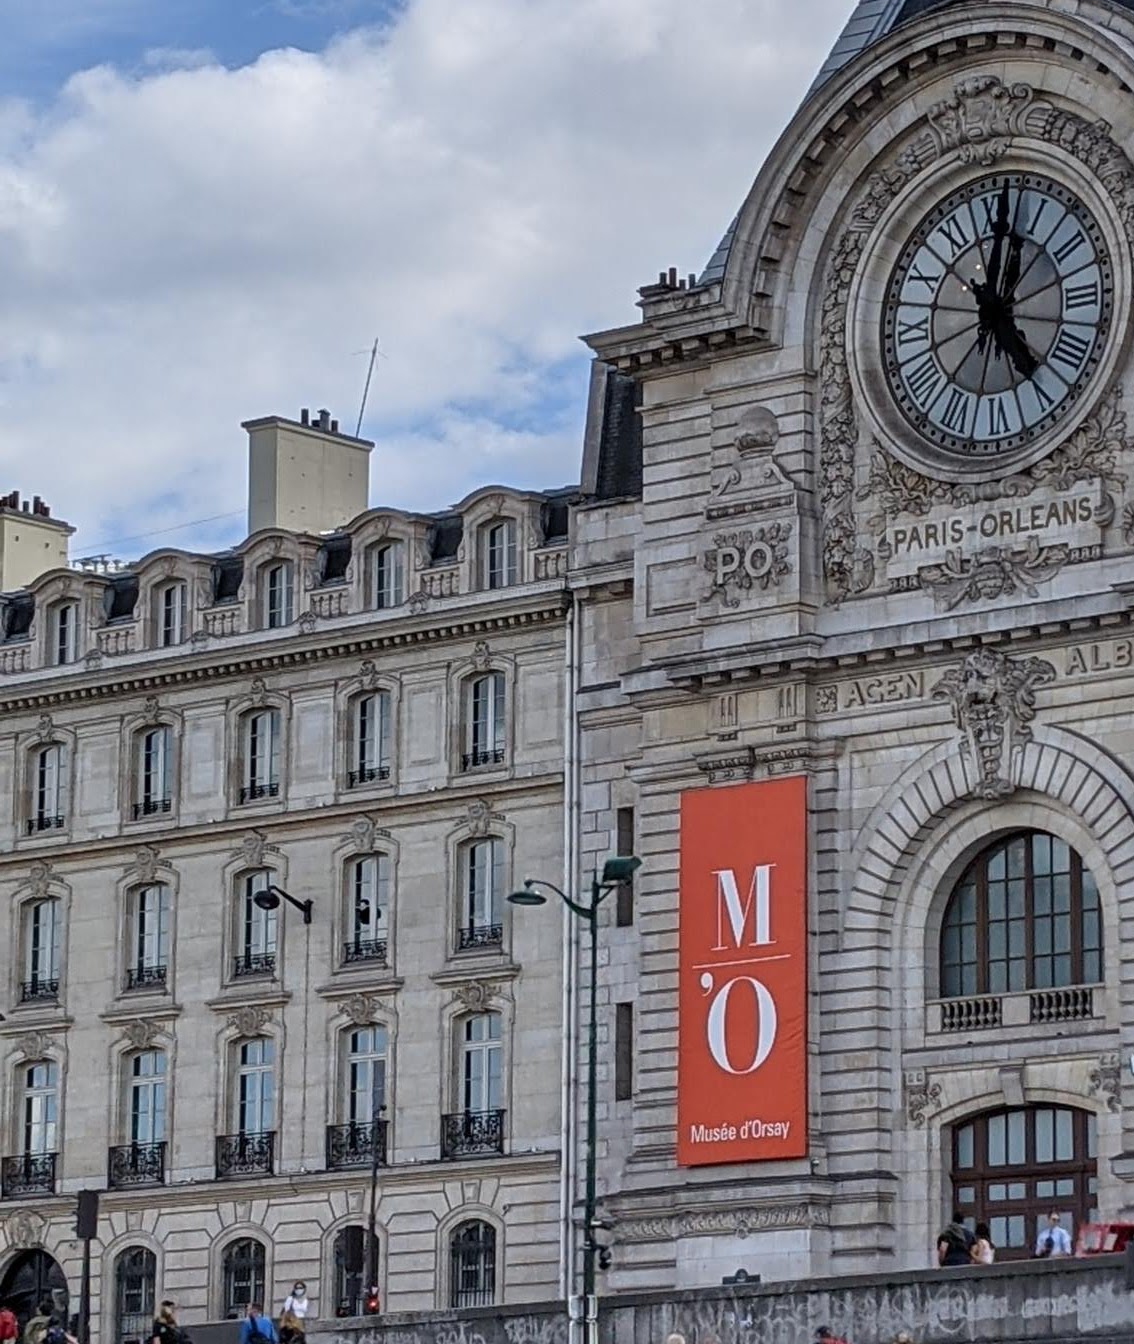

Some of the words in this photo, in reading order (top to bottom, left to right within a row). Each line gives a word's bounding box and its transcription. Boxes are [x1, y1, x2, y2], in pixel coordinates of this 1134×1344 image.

[937, 215, 970, 257] XI
[1053, 229, 1085, 265] II
[908, 264, 941, 294] X
[1065, 281, 1098, 312] III
[893, 496, 1093, 554] PARIS-ORLEANS
[717, 541, 773, 585] PO
[844, 671, 924, 709] AGEN
[711, 863, 777, 951] M
[691, 1122, 737, 1144] Musée
[740, 1119, 790, 1140] d'Orsay
